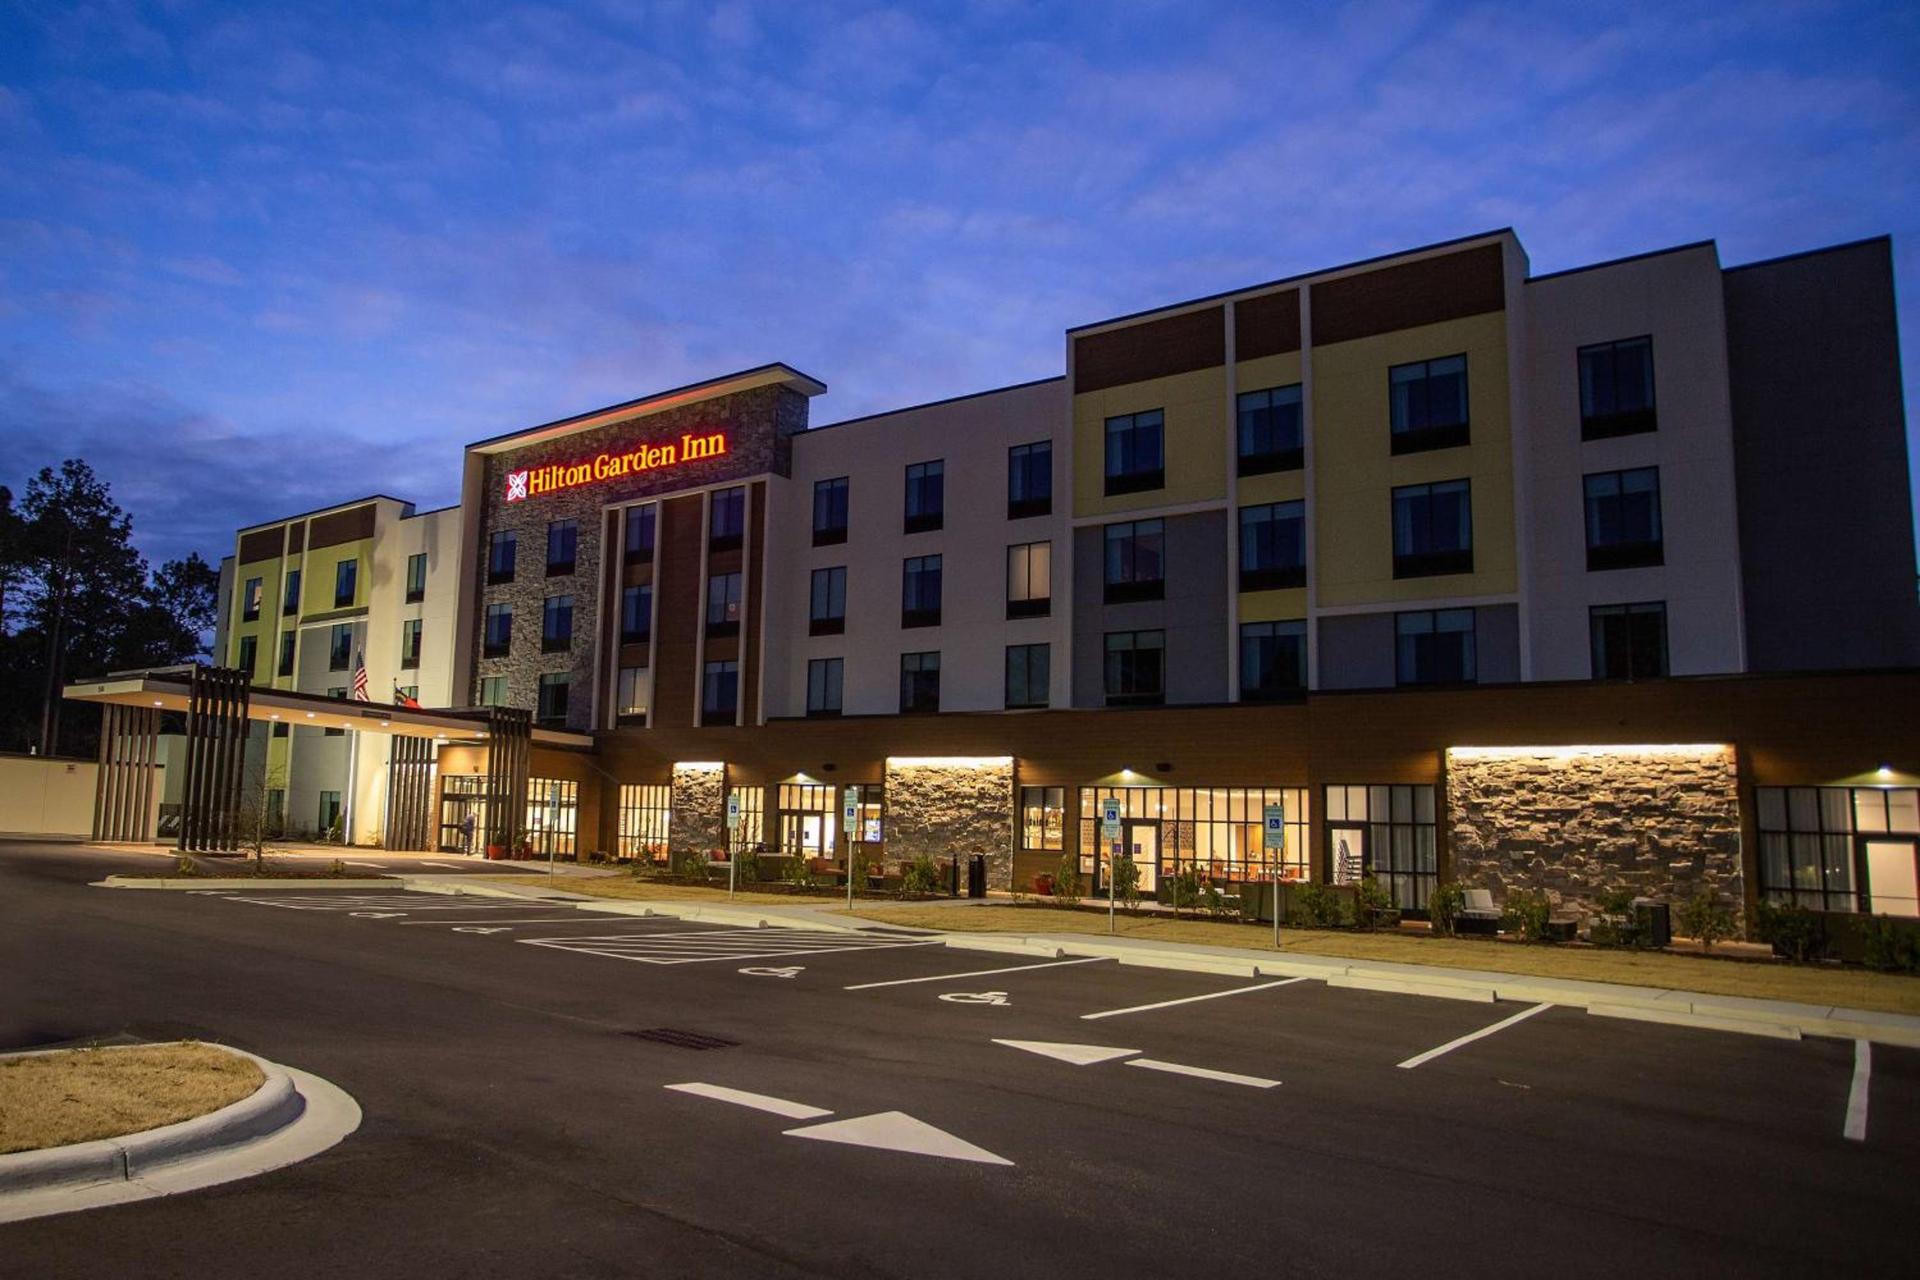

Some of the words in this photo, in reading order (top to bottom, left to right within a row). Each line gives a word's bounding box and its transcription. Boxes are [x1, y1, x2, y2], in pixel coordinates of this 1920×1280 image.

[529, 462, 591, 494] Hilton
[594, 445, 675, 479] Garden
[681, 434, 725, 461] Inn
